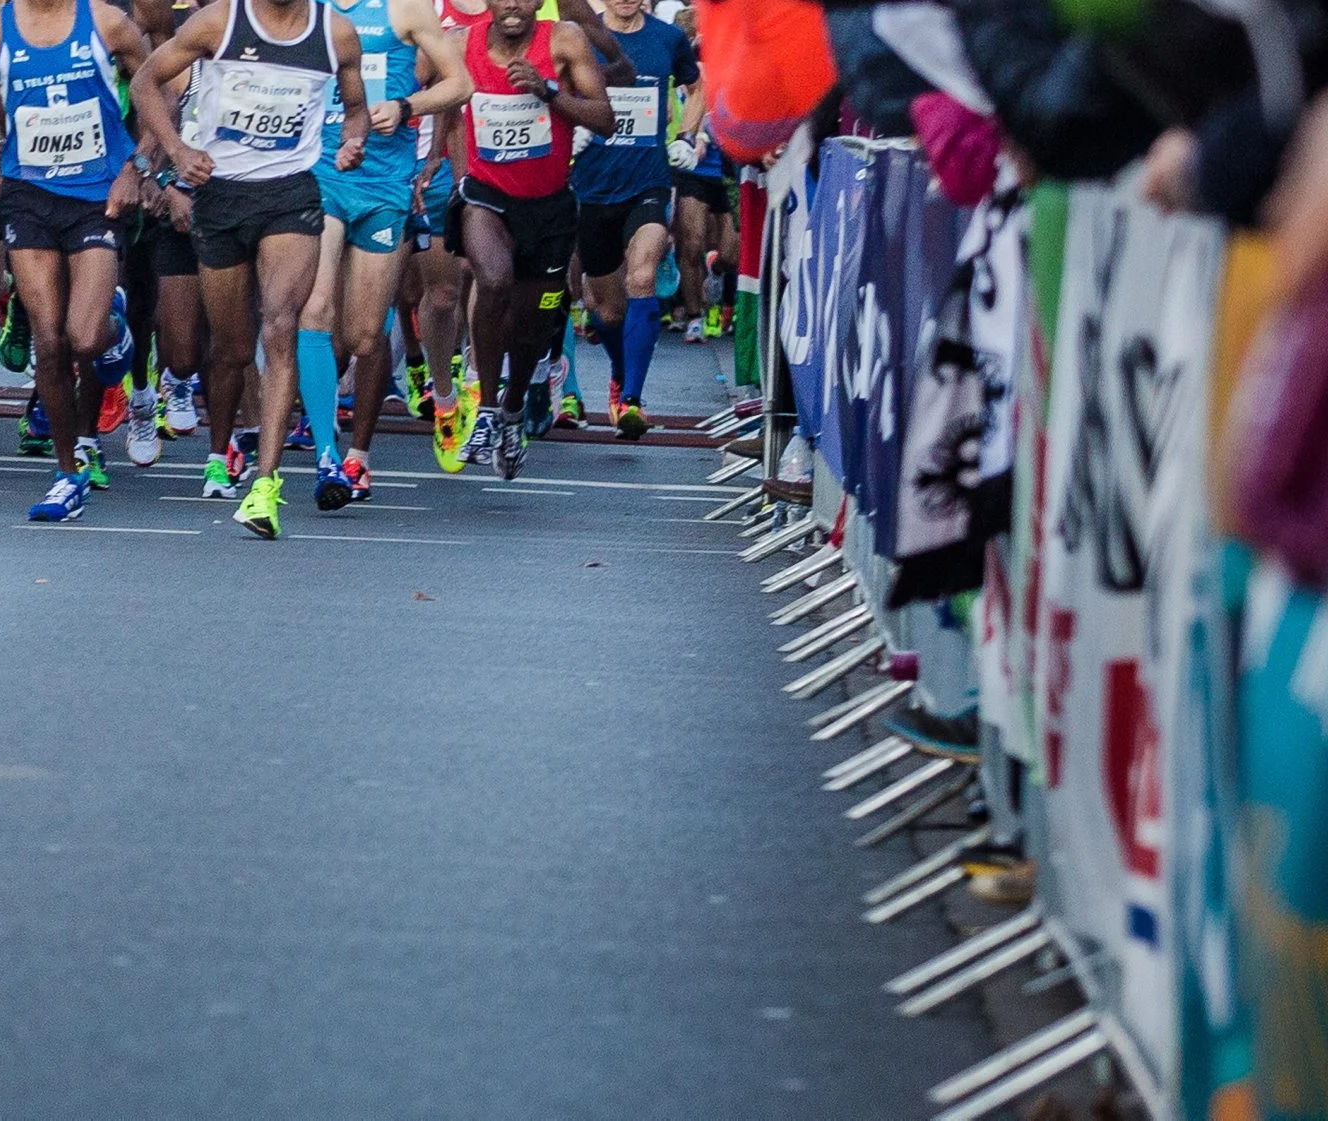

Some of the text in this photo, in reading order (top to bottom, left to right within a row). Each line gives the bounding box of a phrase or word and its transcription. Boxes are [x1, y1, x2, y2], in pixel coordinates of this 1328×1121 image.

[228, 109, 296, 135] 11895
[616, 117, 635, 136] 88
[29, 131, 85, 153] JONAS
[493, 126, 532, 147] 625
